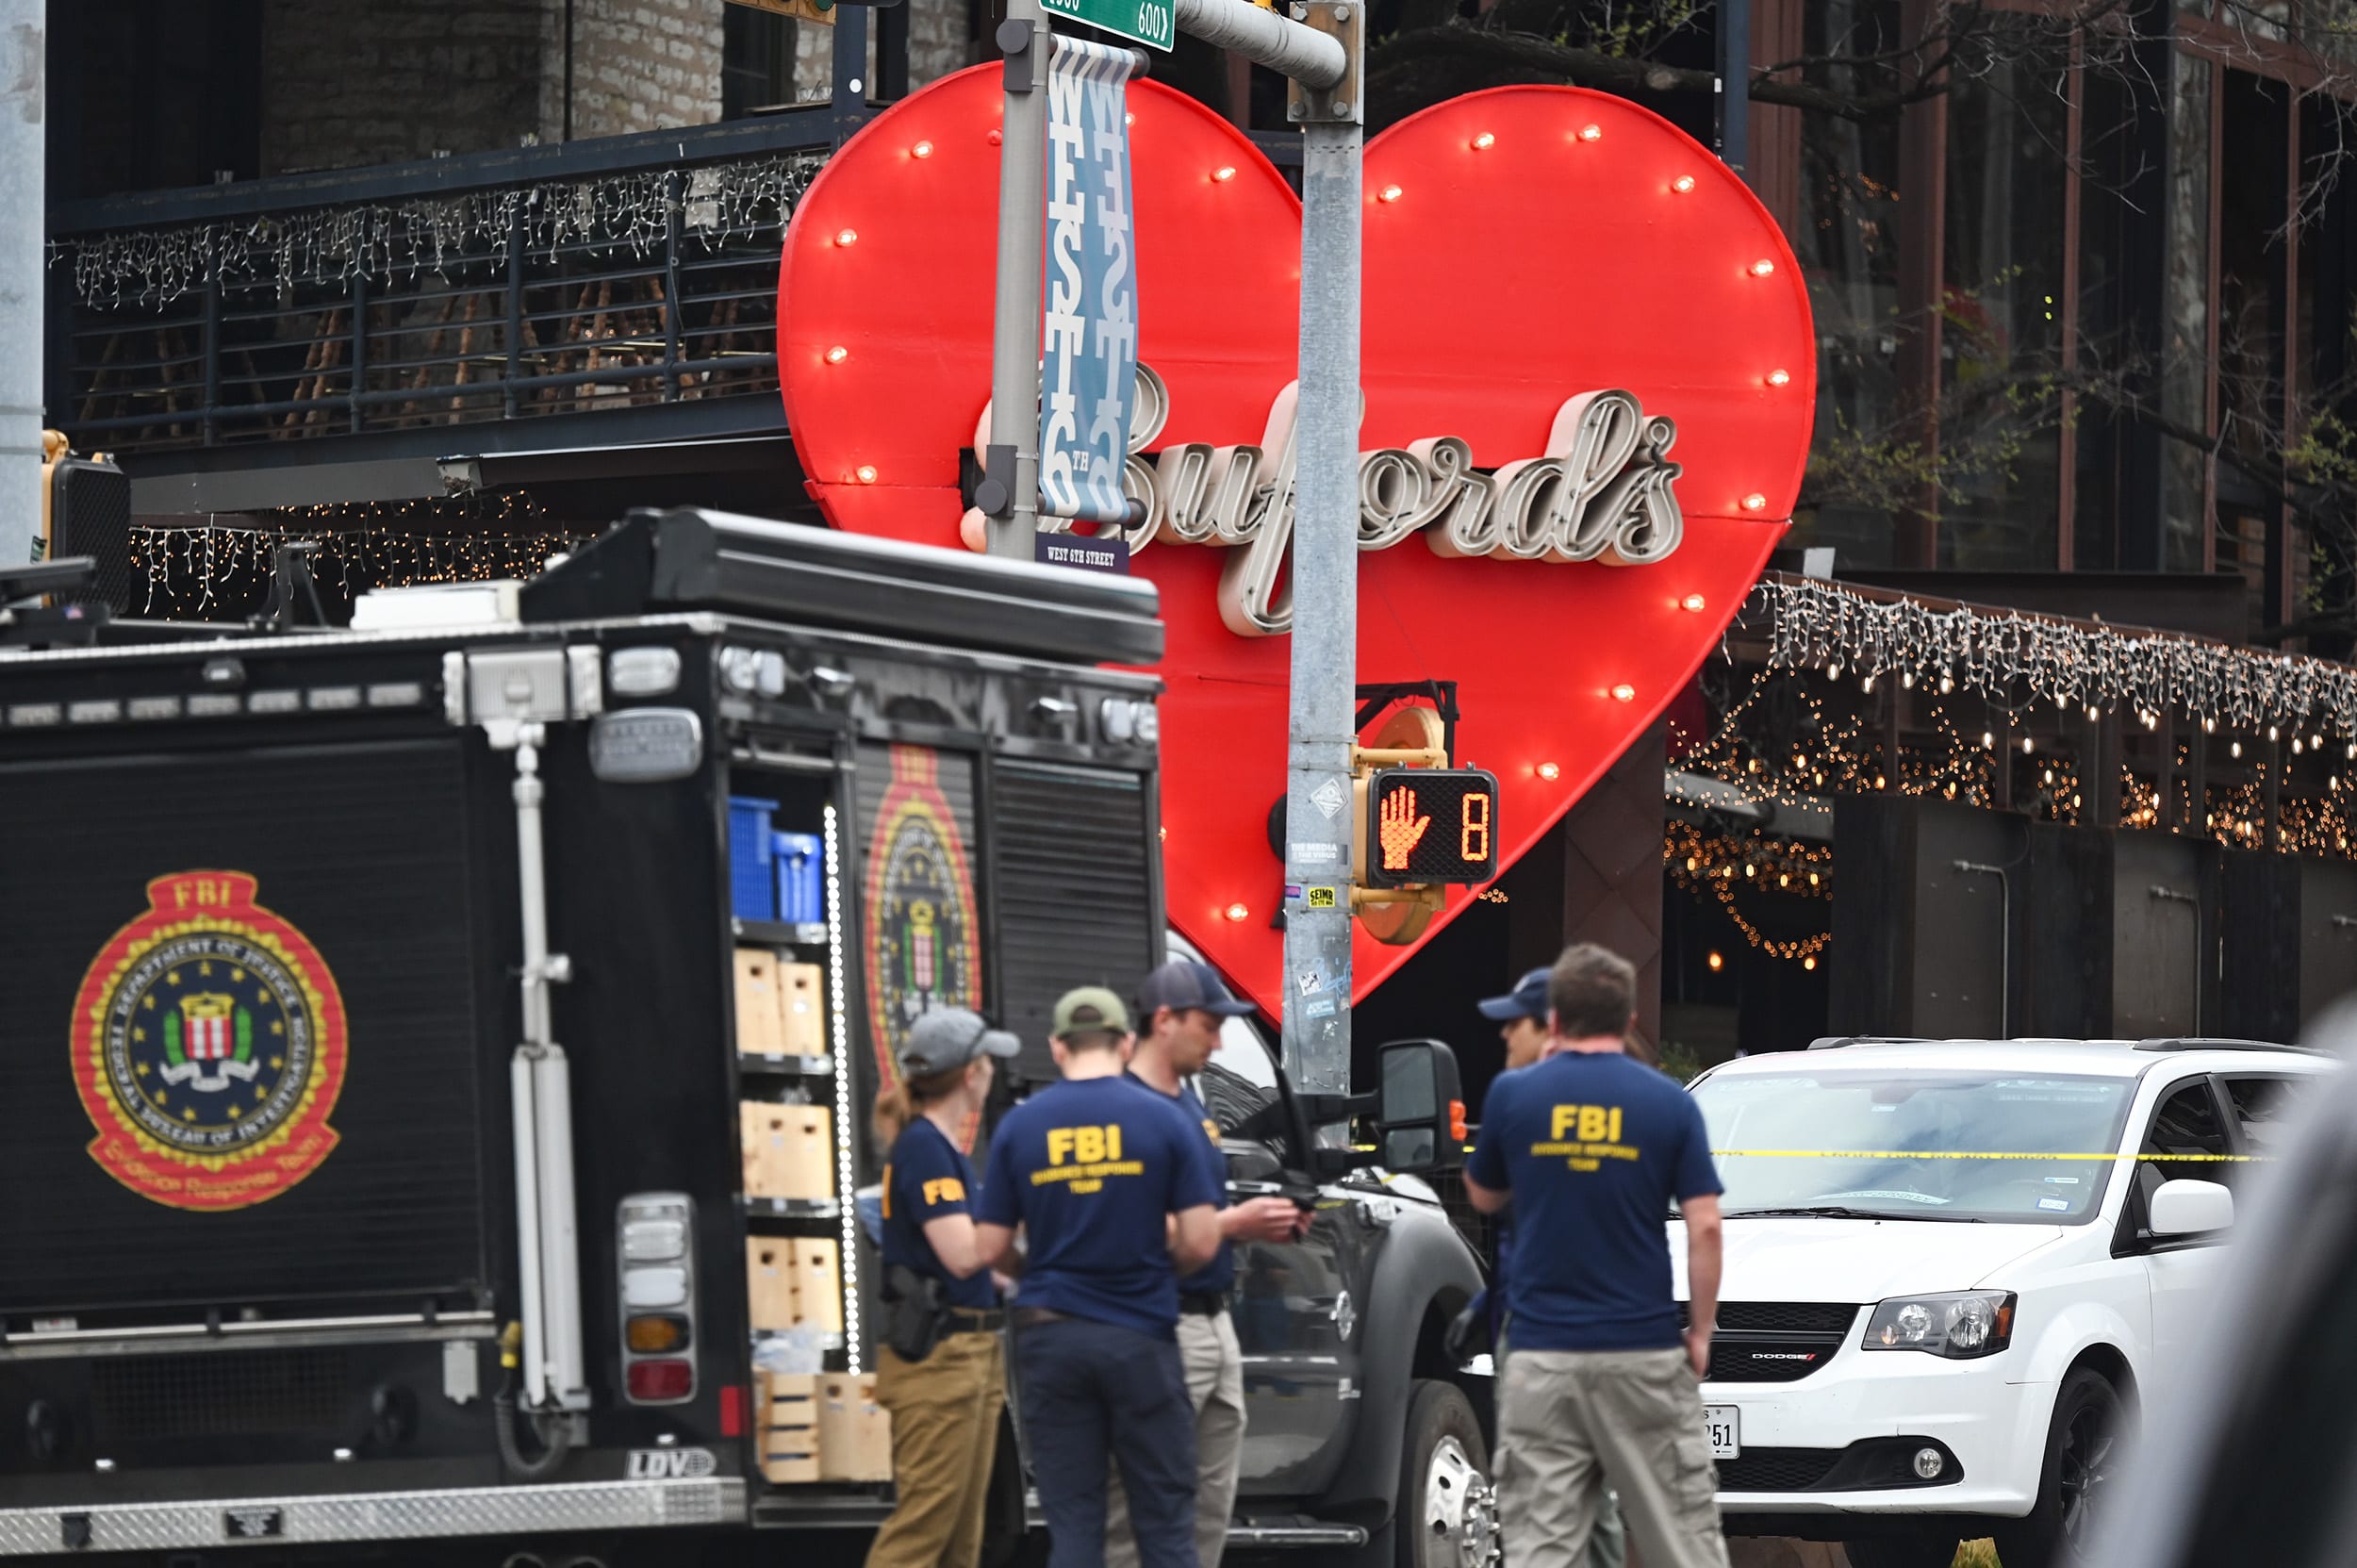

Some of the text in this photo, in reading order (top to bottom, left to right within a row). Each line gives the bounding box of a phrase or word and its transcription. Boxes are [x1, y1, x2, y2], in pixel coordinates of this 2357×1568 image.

[1139, 2, 1160, 39] 600
[1046, 36, 1094, 412] WEST
[1047, 546, 1115, 567] WEST 6TH STREET
[1462, 793, 1489, 861] 8
[1307, 843, 1338, 852] MEDIA
[173, 879, 232, 909] FBI
[1551, 1104, 1623, 1143] FBI
[1047, 1124, 1121, 1165] FBI
